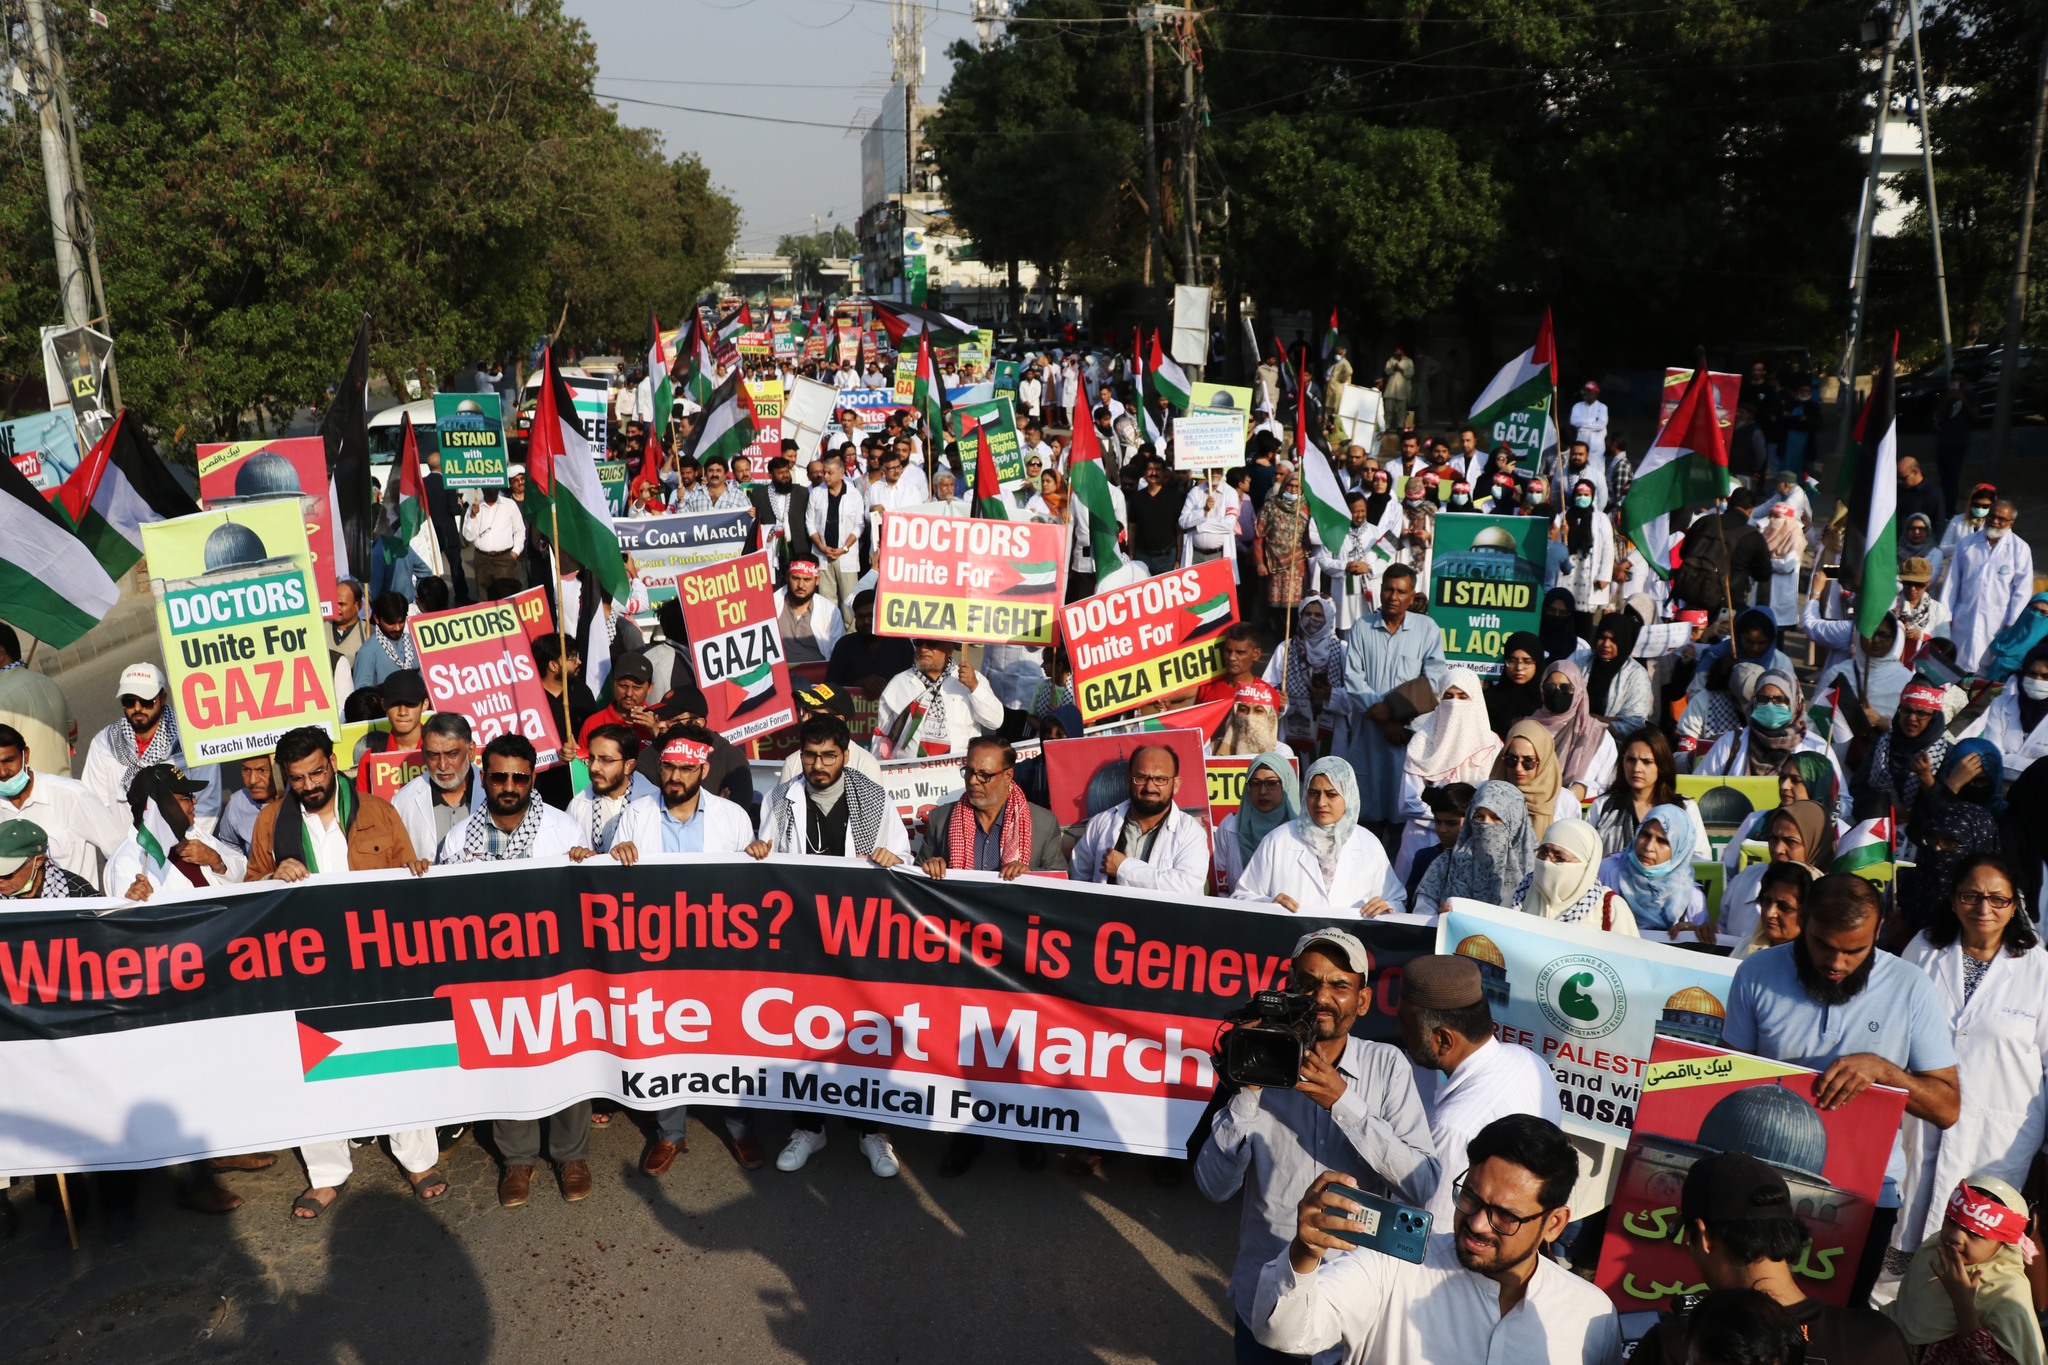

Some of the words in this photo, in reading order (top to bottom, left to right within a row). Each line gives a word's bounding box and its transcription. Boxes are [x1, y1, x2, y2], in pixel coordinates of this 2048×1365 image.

[775, 343, 795, 352] GAZA
[899, 361, 918, 371] DOCT
[895, 379, 914, 396] GA
[445, 432, 451, 446] I
[452, 431, 496, 447] STAND
[987, 431, 1015, 445] estern
[1493, 421, 1540, 448] GAZA
[463, 450, 483, 459] with
[960, 449, 978, 461] Hum
[990, 440, 1017, 454] Rights
[992, 453, 1010, 464] pply
[1010, 452, 1019, 460] to
[444, 460, 462, 475] AL
[466, 459, 504, 475] AQSA
[886, 515, 1031, 559] DOCTORS
[683, 563, 741, 606] Stand
[744, 562, 768, 592] up
[887, 556, 949, 586] Unite
[956, 561, 994, 588] For
[168, 578, 305, 629] DOCTORS
[1065, 570, 1202, 641] DOCTORS
[1443, 580, 1451, 603] I
[1455, 581, 1530, 609] STAND
[519, 597, 544, 622] up
[716, 599, 747, 629] For
[886, 598, 957, 632] GAZA
[966, 604, 1048, 638] FIGHT
[1468, 613, 1501, 629] with
[418, 609, 516, 649] DOCTORS
[181, 633, 256, 669] Unite
[262, 625, 307, 656] For
[701, 624, 781, 681] GAZA
[1076, 635, 1134, 671] Unite
[1138, 622, 1175, 650] For
[1465, 630, 1514, 658] AQS
[428, 650, 535, 700] Stands
[1085, 668, 1152, 712] GAZA
[1158, 641, 1227, 689] FIGHT
[1466, 663, 1498, 673] Medical
[181, 655, 330, 730] GAZA
[471, 691, 512, 718] with
[723, 731, 744, 745] arachi
[743, 720, 769, 736] Medical
[770, 712, 790, 728] Forum
[200, 739, 244, 757] Karachi
[535, 753, 555, 765] orum
[888, 786, 911, 801] AND
[0, 936, 206, 1006] Where
[226, 926, 327, 982] are
[344, 908, 560, 970] Human
[580, 889, 794, 963] Rights?
[815, 894, 1003, 968] Where
[1024, 915, 1072, 979] is
[1541, 956, 1596, 981] OBSTETRICIANS
[1538, 981, 1545, 991] OF
[1603, 966, 1624, 1026] GYNAECOLOGISTS
[1538, 992, 1559, 1023] SOCIETY
[469, 982, 712, 1056] White
[741, 987, 930, 1062] Coat
[957, 1004, 1214, 1089] March
[1560, 1022, 1597, 1037] PAKISTAN
[1601, 1025, 1611, 1034] OF
[1542, 1035, 1650, 1079] PALEST
[1549, 1063, 1603, 1093] tand
[1610, 1080, 1642, 1103] wi
[621, 1066, 767, 1099] Karachi
[782, 1071, 936, 1116] Medical
[950, 1089, 1080, 1133] Forum
[1397, 1243, 1414, 1254] POCO
